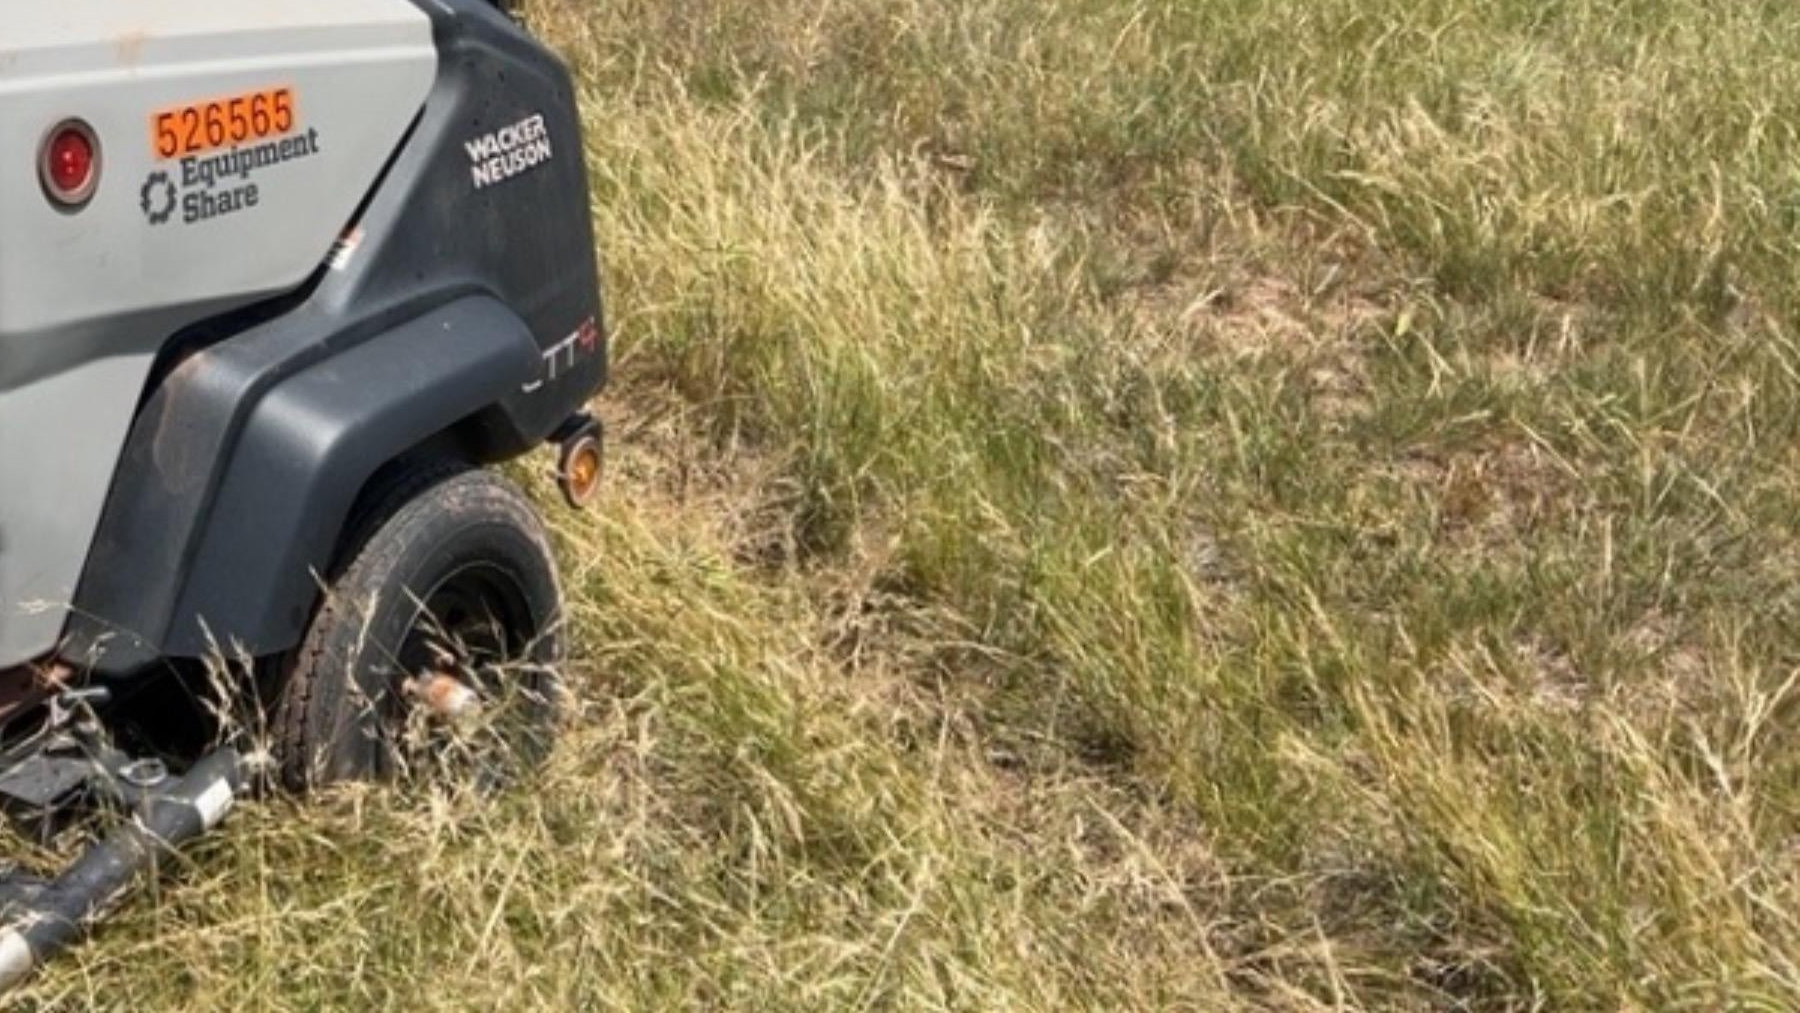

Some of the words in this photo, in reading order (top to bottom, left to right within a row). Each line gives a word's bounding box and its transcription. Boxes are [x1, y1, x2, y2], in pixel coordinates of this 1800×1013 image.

[156, 88, 293, 159] 526565
[464, 112, 547, 163] WACKER
[180, 126, 319, 188] Equipment
[471, 137, 551, 189] NEUSON
[182, 182, 259, 224] Share
